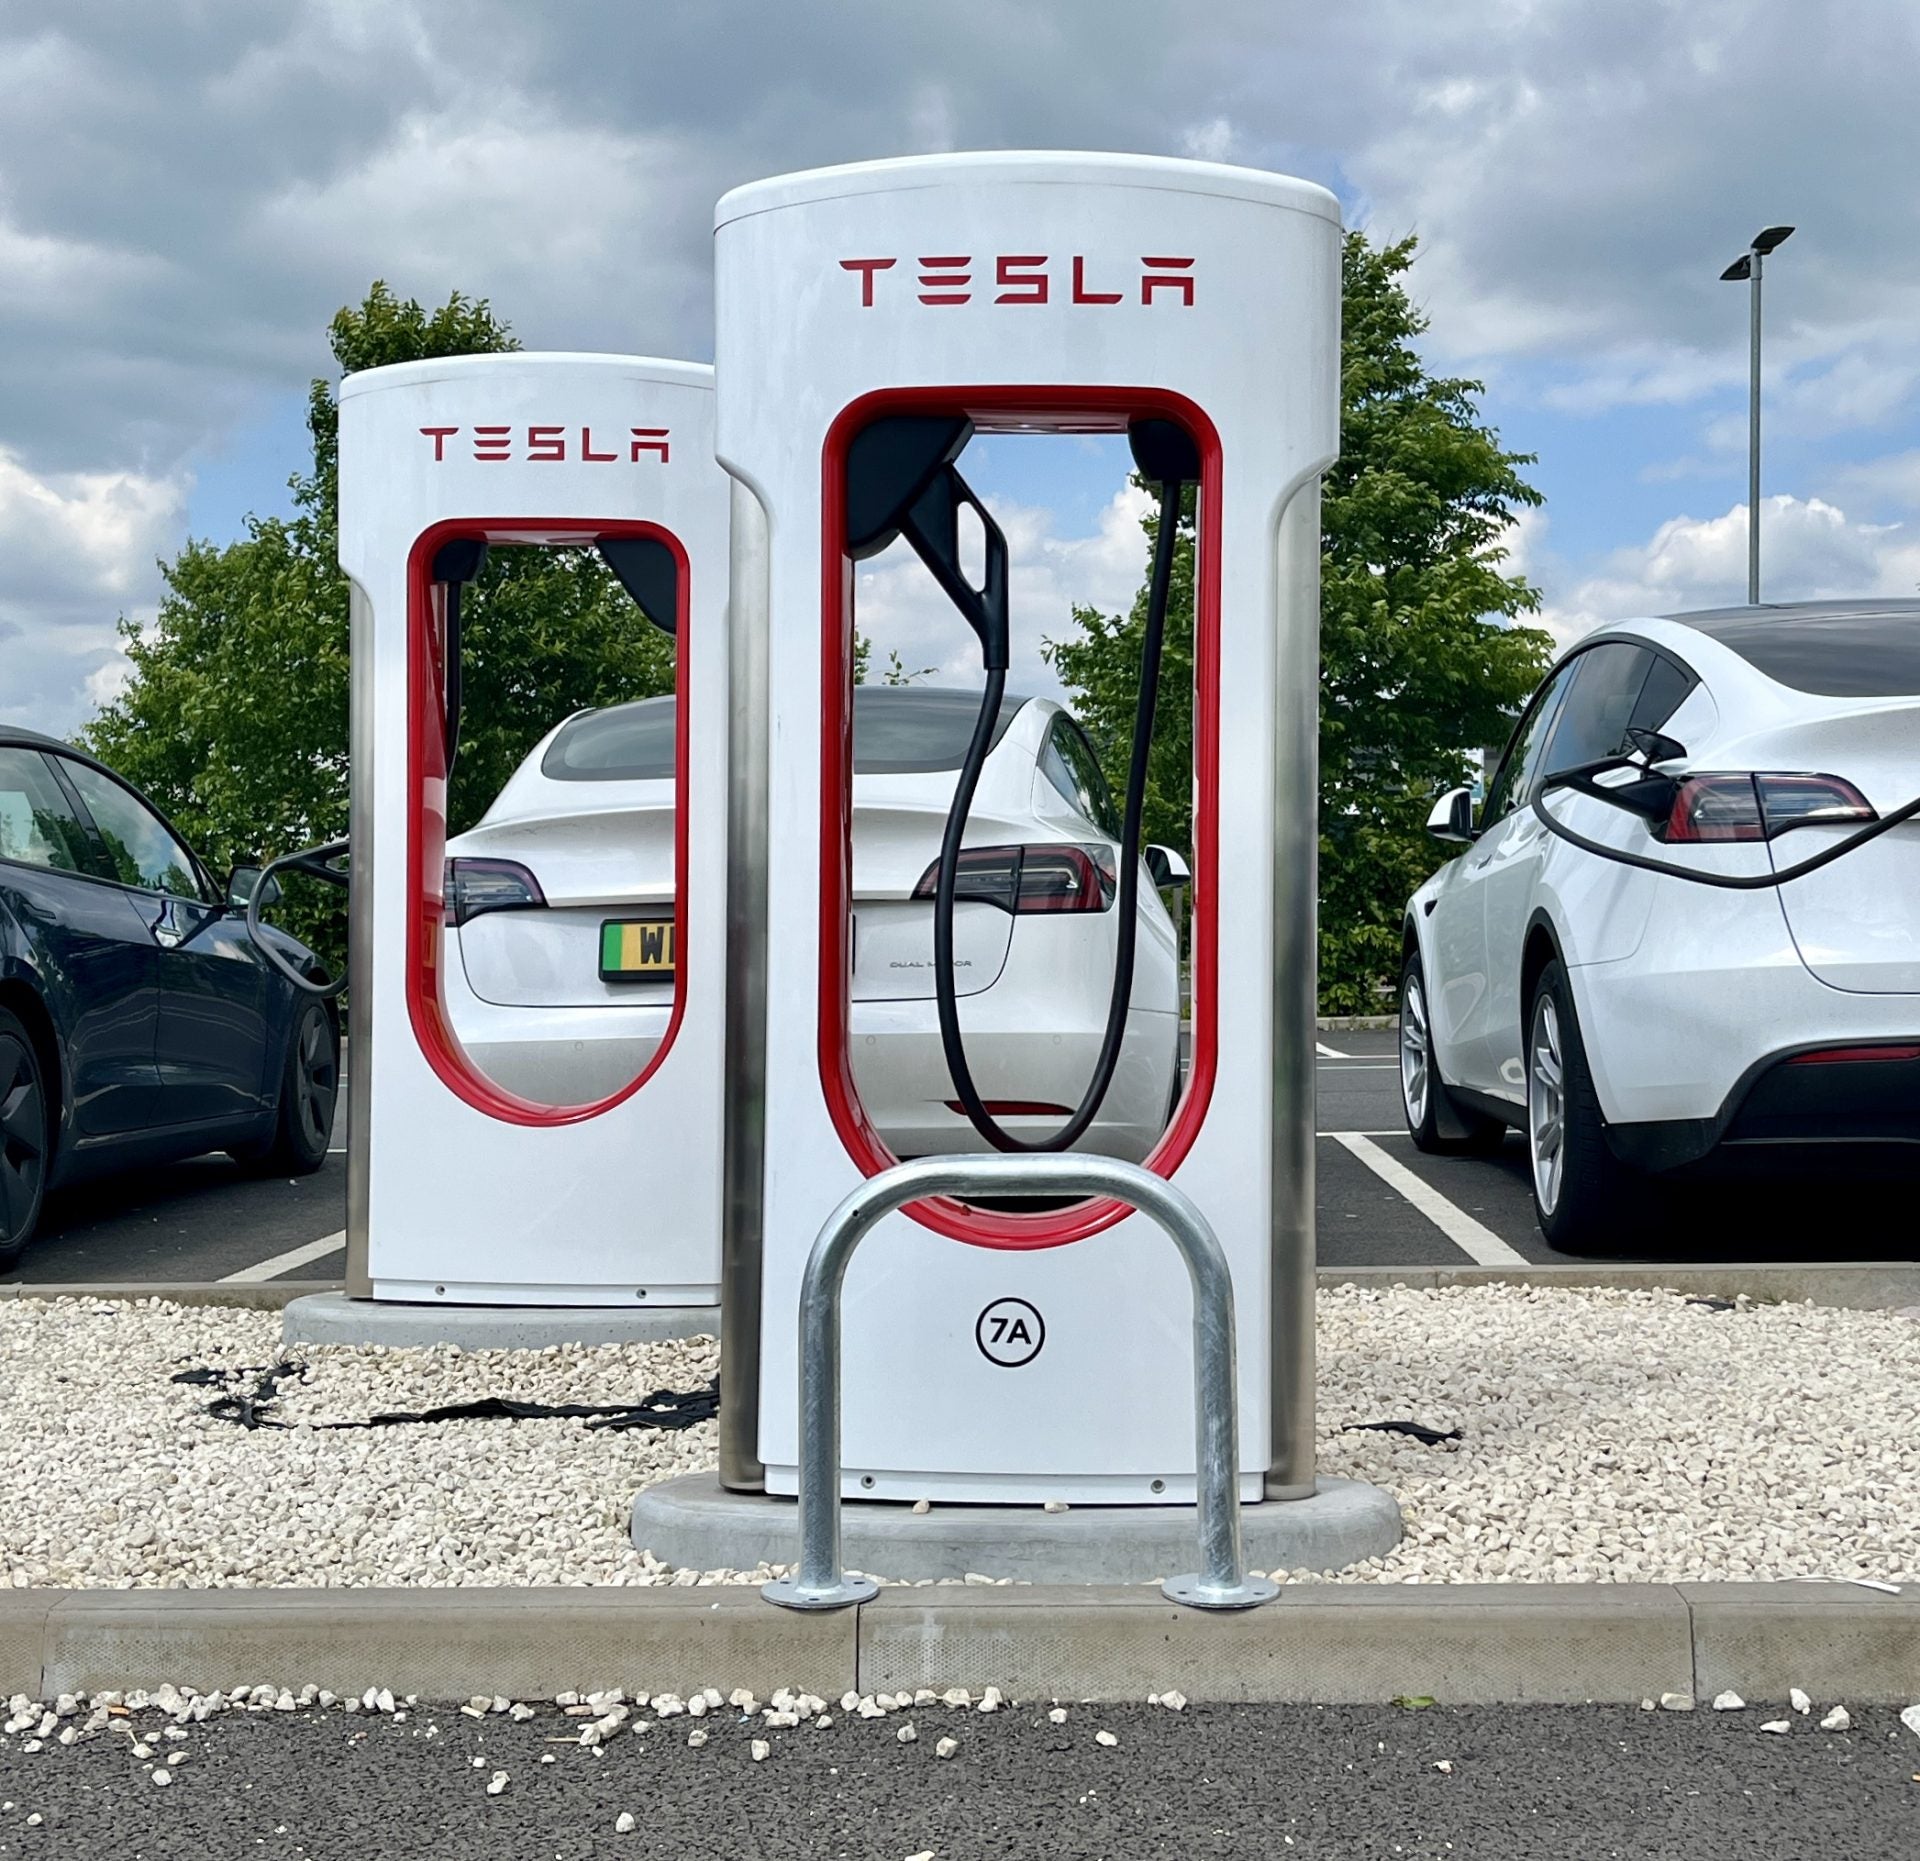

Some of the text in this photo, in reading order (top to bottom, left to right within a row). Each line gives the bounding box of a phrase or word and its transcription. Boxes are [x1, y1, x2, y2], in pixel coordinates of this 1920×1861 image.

[839, 256, 1195, 307] TESLA
[419, 427, 670, 463] TESLA
[990, 1317, 1032, 1345] 7A
